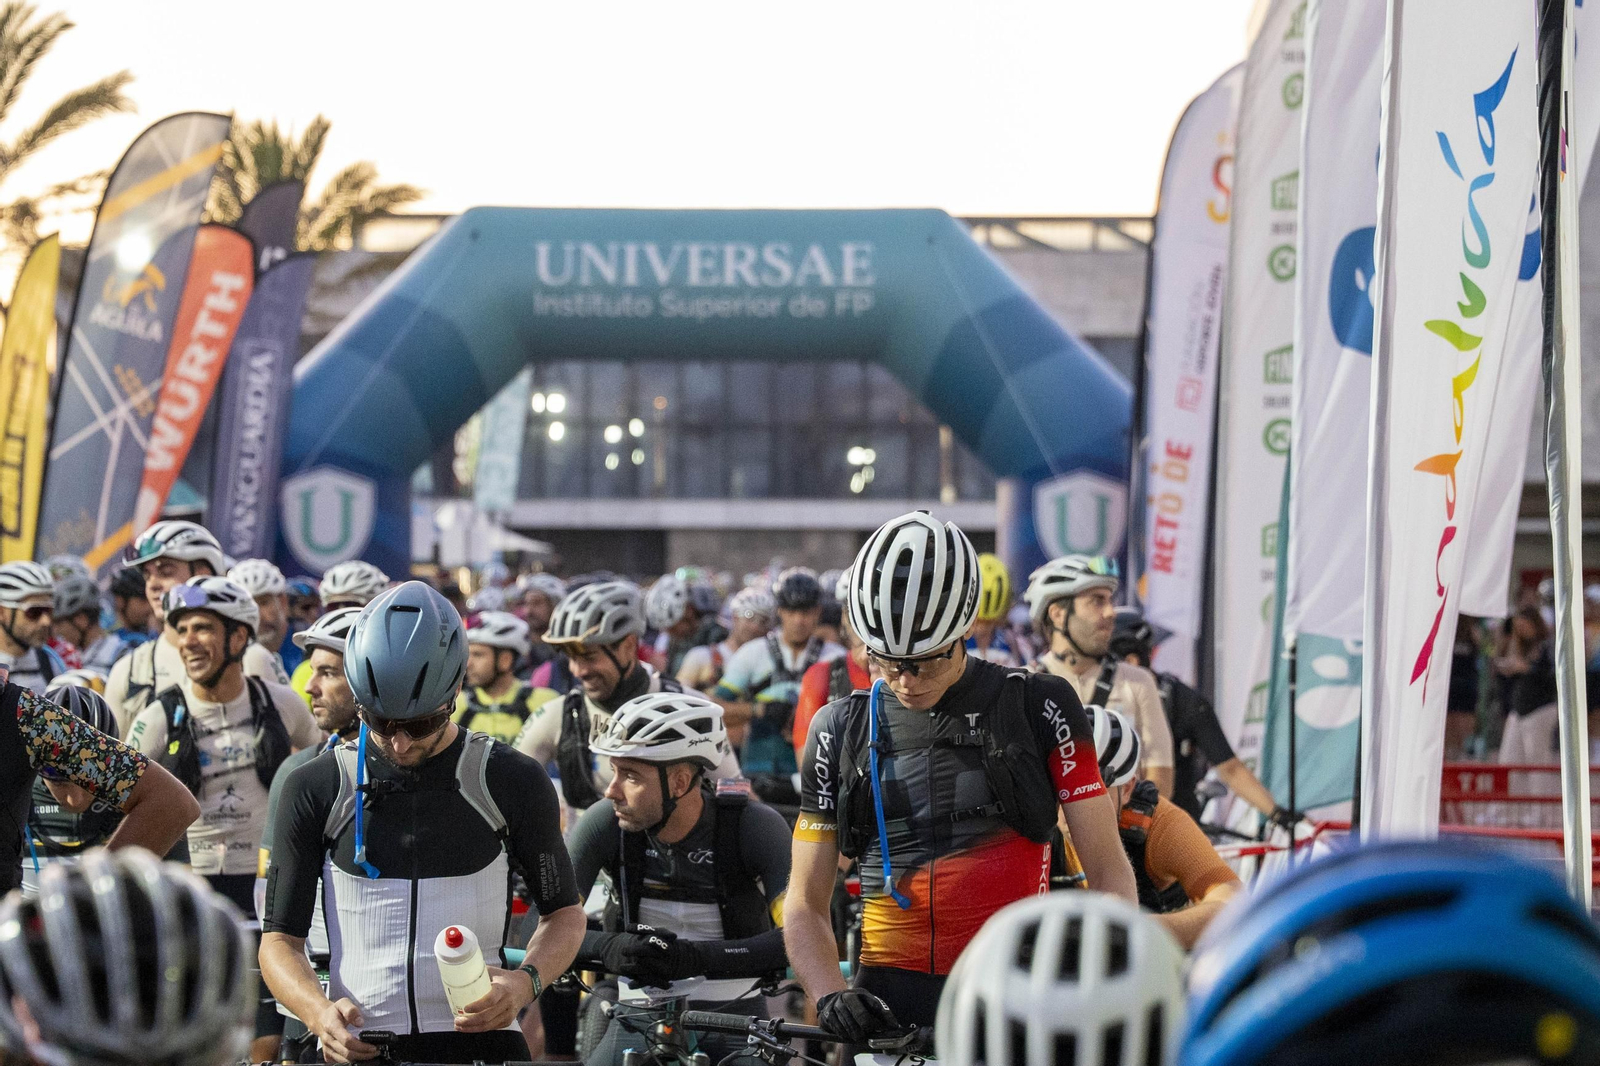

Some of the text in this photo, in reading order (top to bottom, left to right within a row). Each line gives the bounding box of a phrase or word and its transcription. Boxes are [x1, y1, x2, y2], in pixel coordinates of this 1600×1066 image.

[534, 241, 877, 288] UNIVERSAE
[532, 289, 876, 323] Instituto Superior de FP
[300, 485, 354, 556] U
[1072, 781, 1102, 796] ATIKA
[809, 822, 838, 831] ATIK
